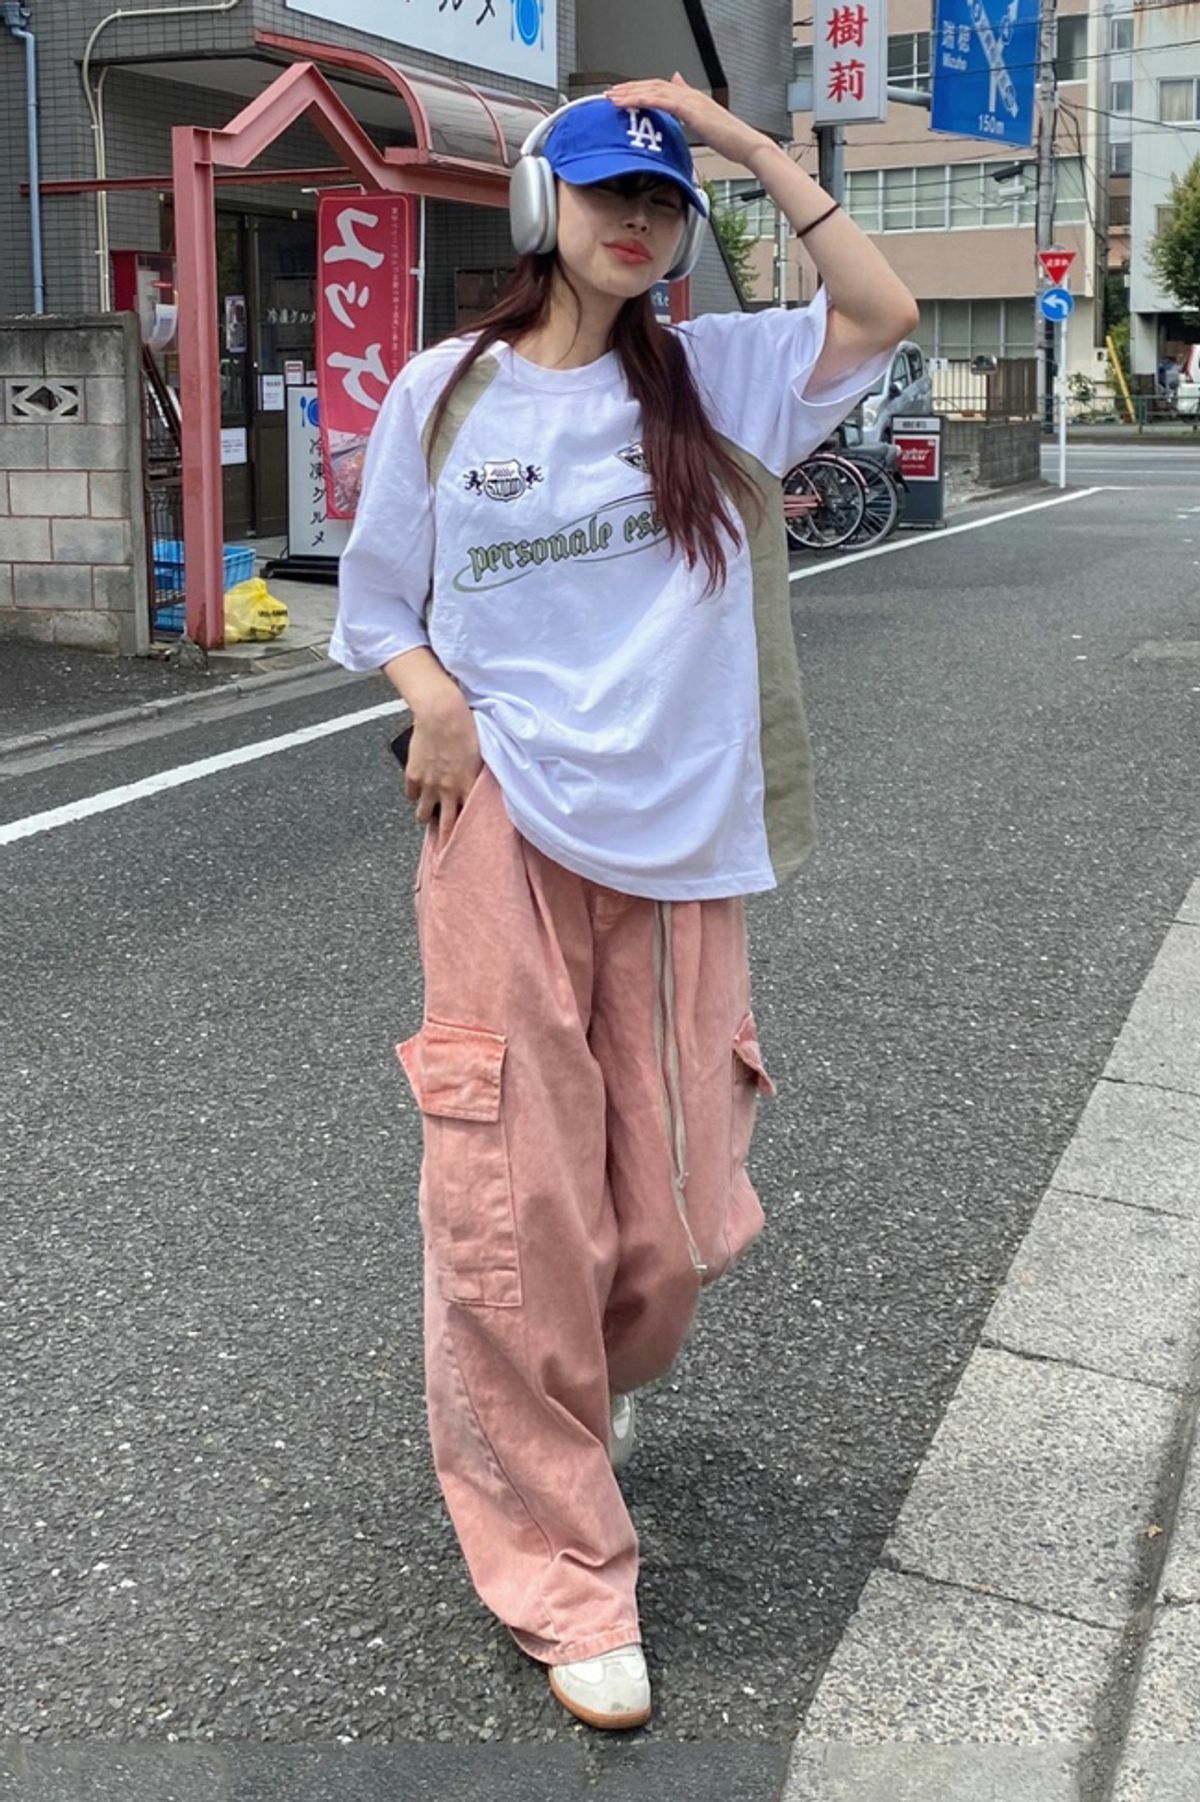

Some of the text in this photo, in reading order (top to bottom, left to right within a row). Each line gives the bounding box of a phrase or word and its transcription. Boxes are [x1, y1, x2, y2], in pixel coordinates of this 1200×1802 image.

[826, 4, 869, 103] 樹莉
[626, 107, 663, 153] LA
[978, 113, 1005, 135] 150m
[467, 515, 613, 582] personale
